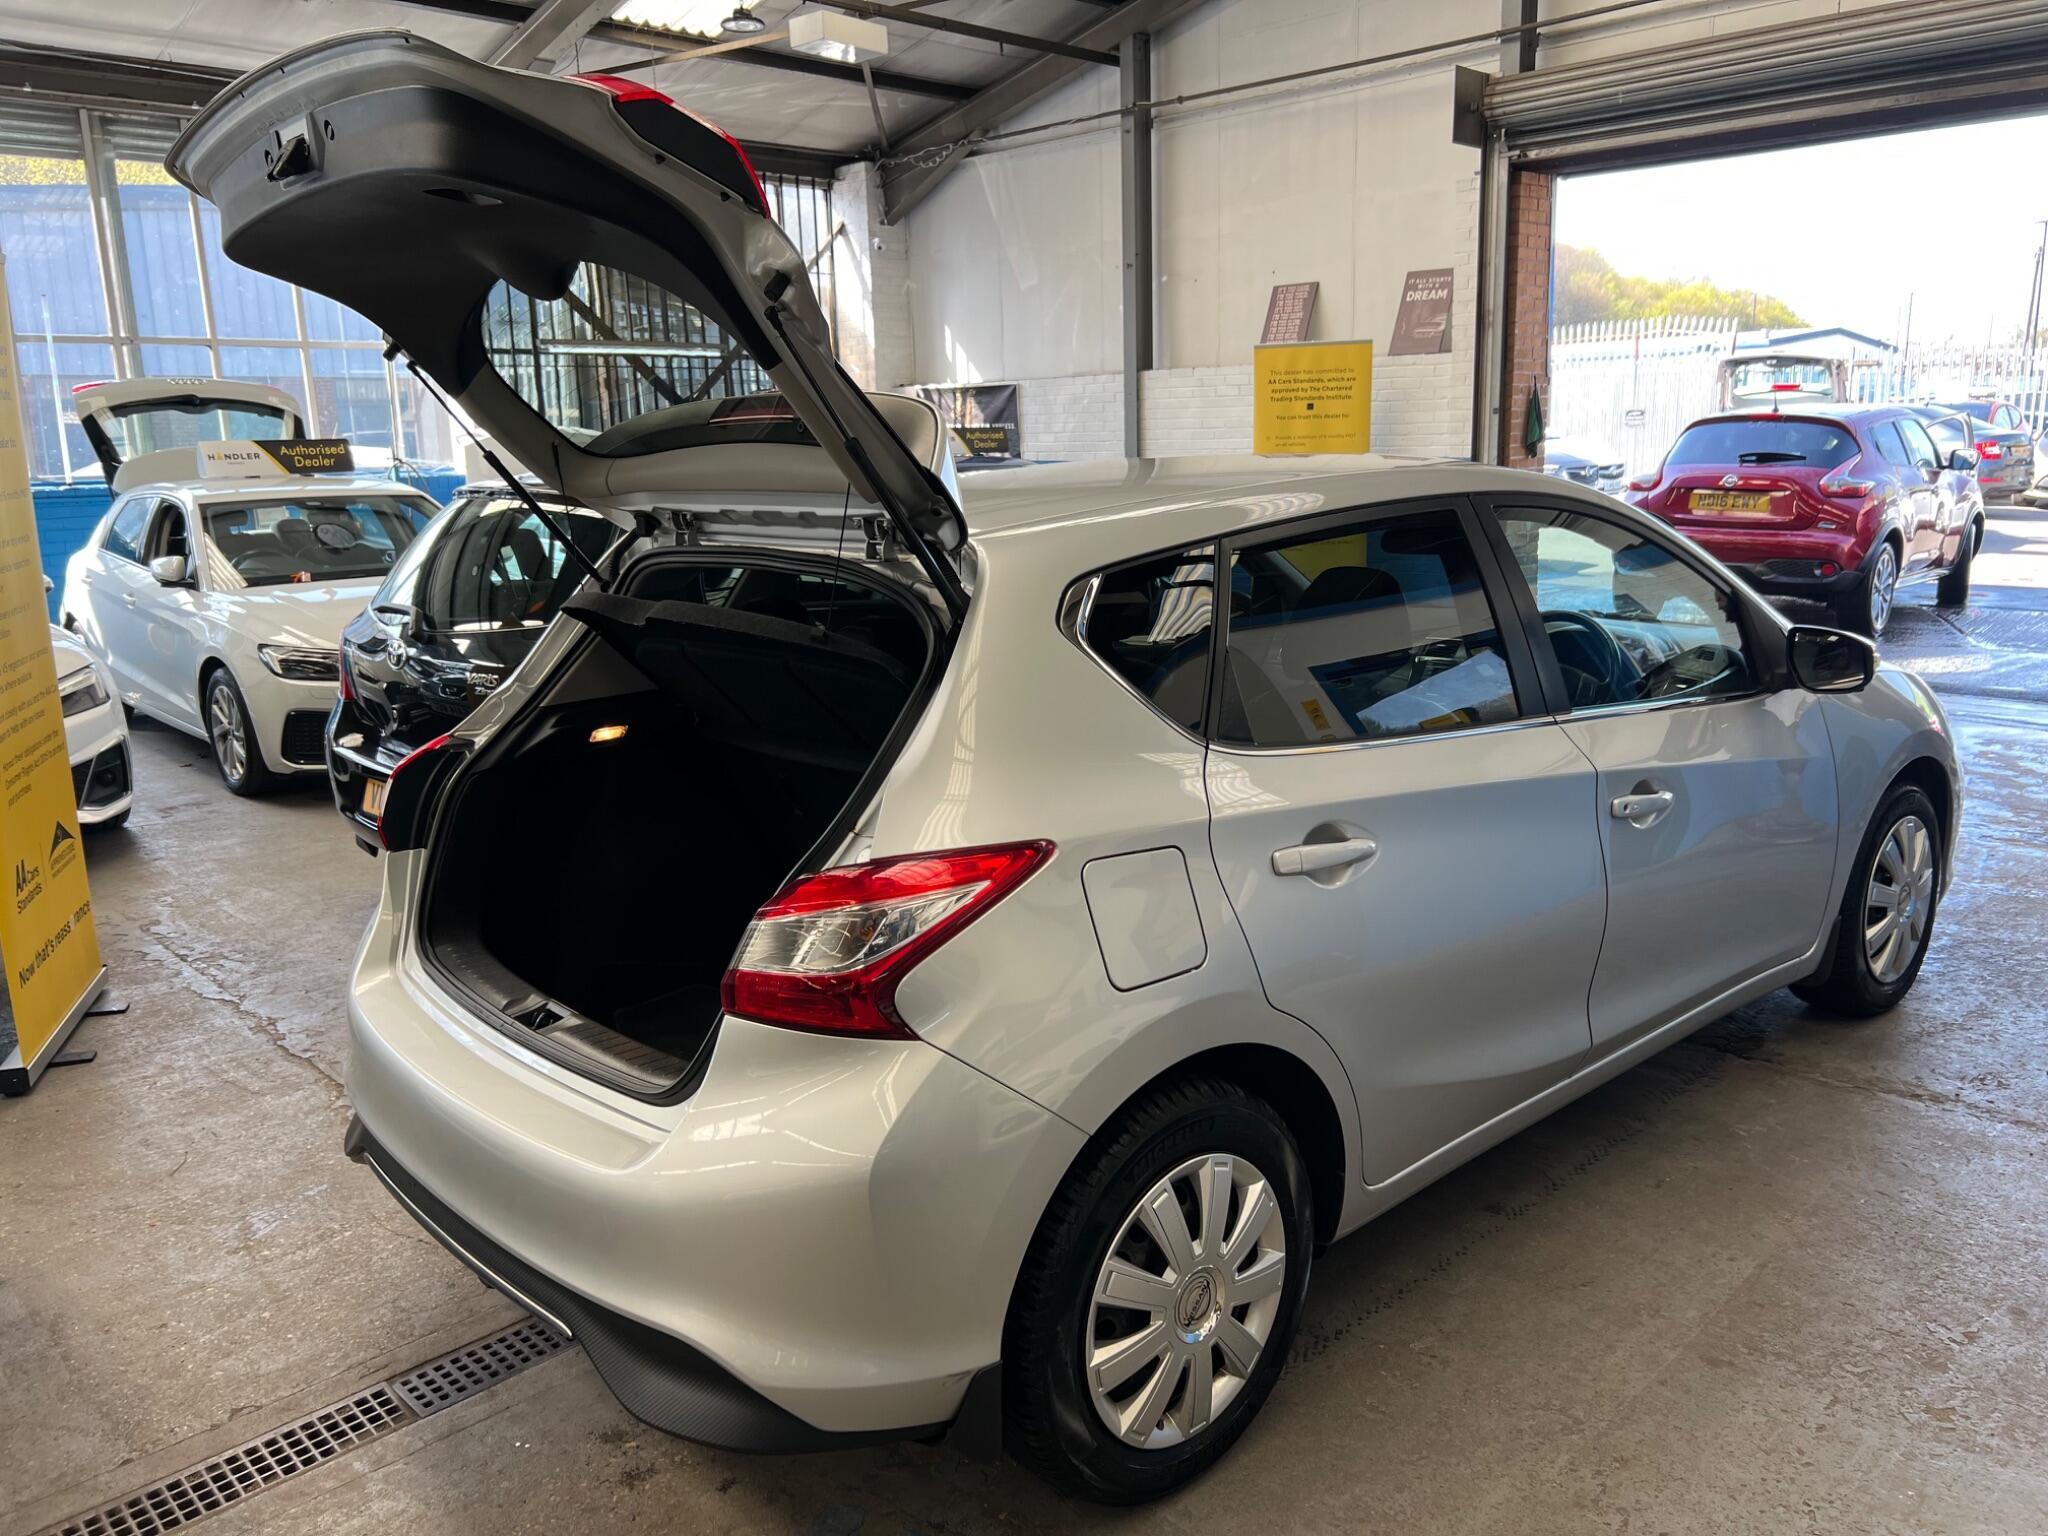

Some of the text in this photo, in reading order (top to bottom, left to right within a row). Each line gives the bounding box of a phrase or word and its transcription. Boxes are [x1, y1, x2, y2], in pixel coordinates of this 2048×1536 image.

[1406, 289, 1448, 301] DREAM
[966, 431, 1004, 440] Authorised
[280, 444, 346, 456] Authorised
[974, 440, 998, 448] Dealer
[293, 455, 336, 467] Dealer
[465, 672, 499, 687] YARIS
[16, 858, 28, 897] AA
[27, 866, 40, 884] Cars
[17, 883, 43, 914] Standards
[18, 961, 36, 990] Now
[35, 938, 55, 968] that's
[54, 900, 90, 948] reassrance
[1188, 1283, 1208, 1319] NISSAN
